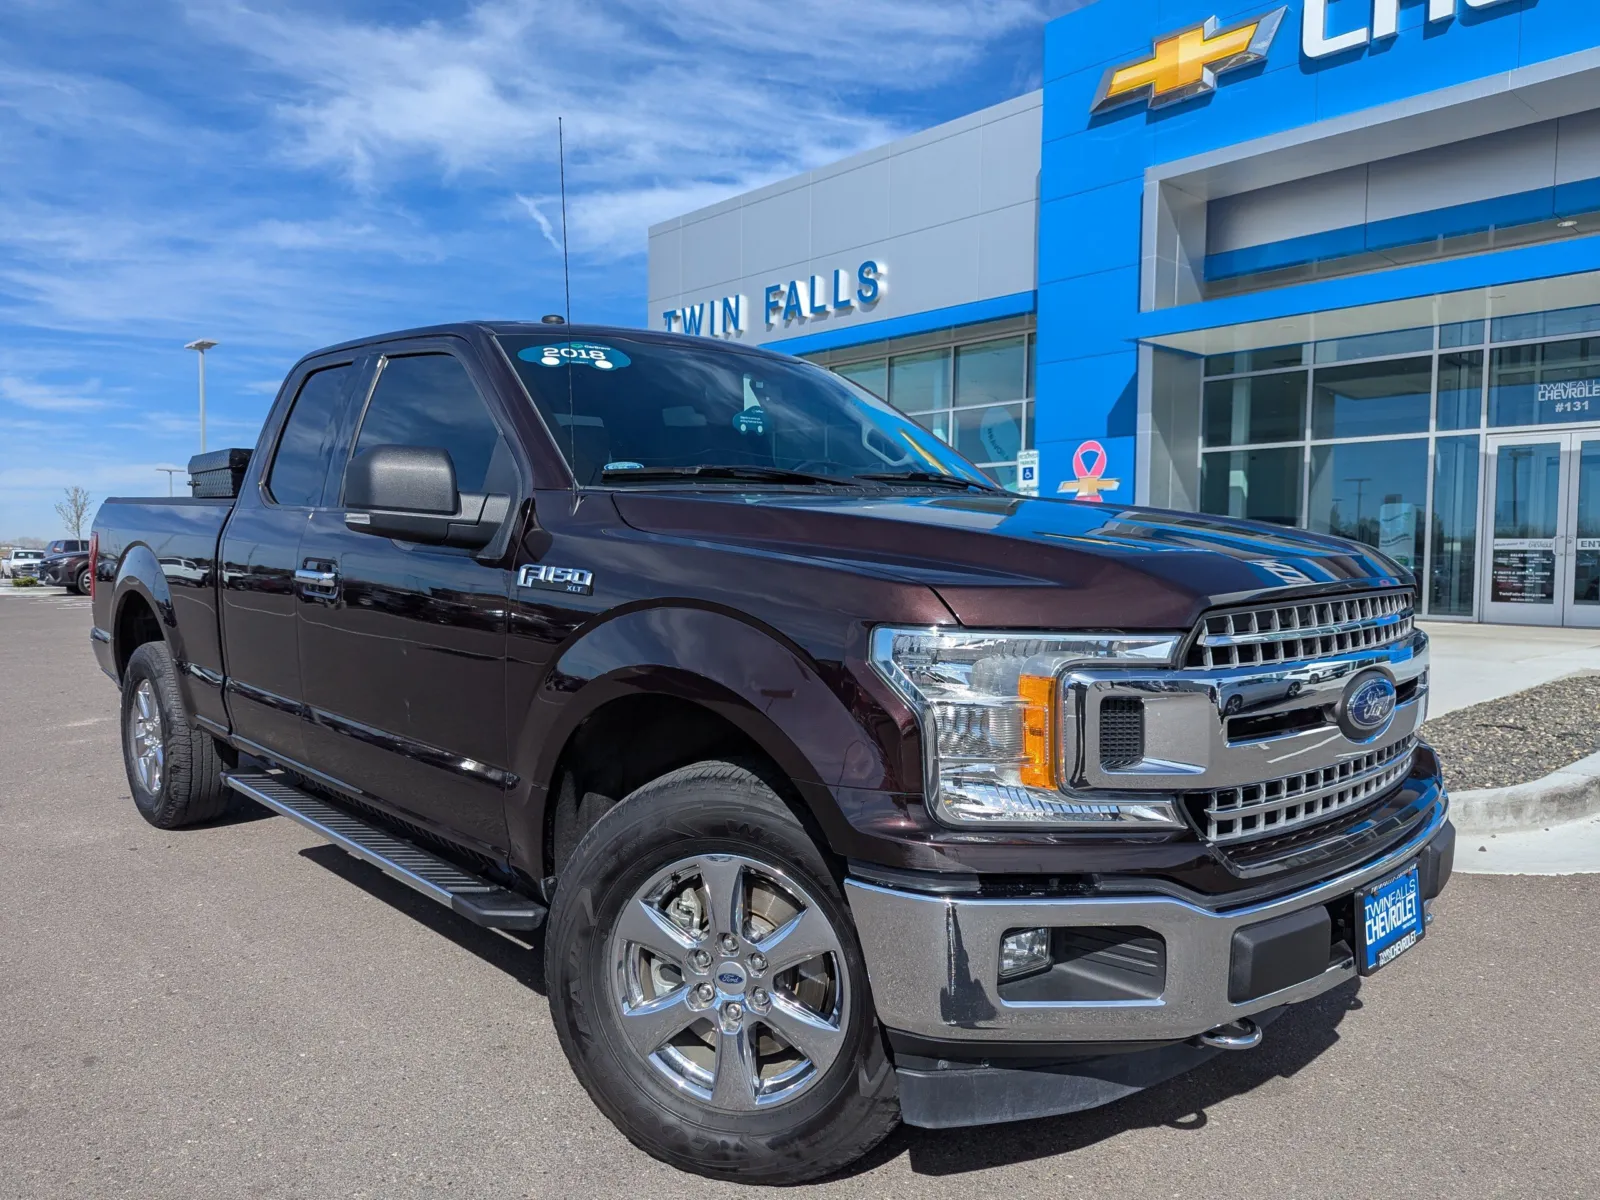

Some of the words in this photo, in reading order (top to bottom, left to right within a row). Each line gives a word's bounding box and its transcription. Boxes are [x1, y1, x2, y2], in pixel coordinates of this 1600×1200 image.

[662, 294, 743, 336] TWIN
[764, 260, 882, 325] FALLS
[543, 347, 606, 360] 2018
[1555, 400, 1589, 413] #131
[1365, 892, 1417, 946] CHEVROLET
[1391, 930, 1417, 958] CHEVROLET
